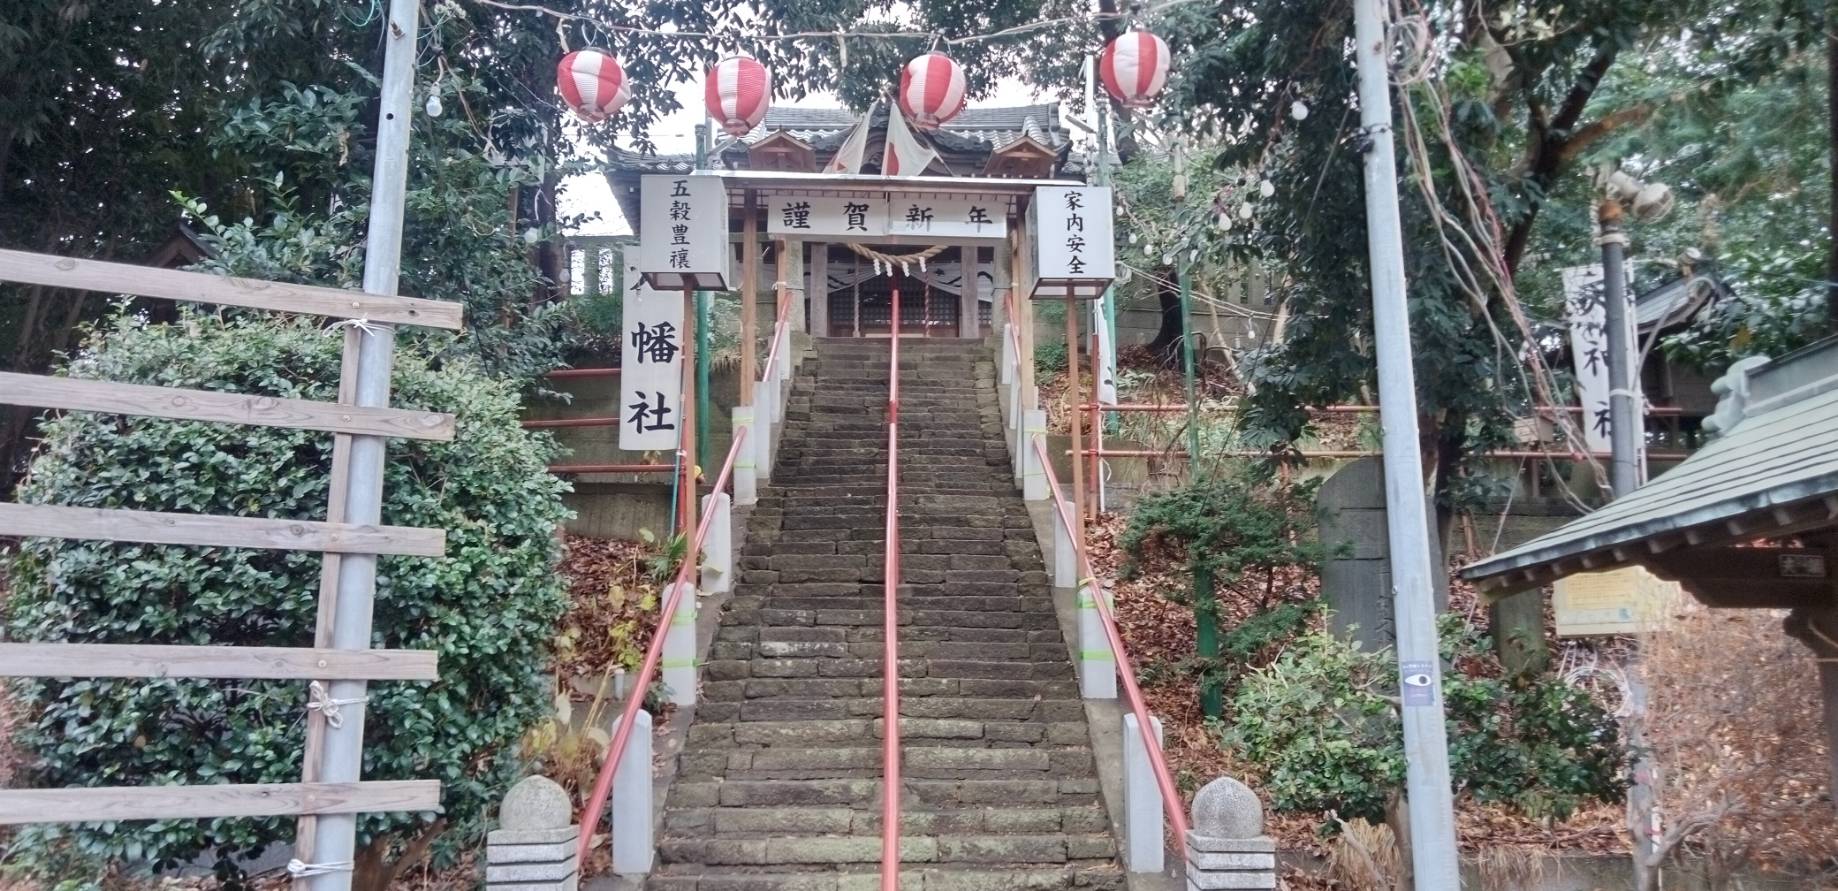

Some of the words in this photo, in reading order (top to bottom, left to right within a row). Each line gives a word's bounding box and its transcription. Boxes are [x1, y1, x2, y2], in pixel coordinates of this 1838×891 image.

[781, 200, 993, 234] 謹賀新年
[1064, 190, 1088, 275] 家内安全
